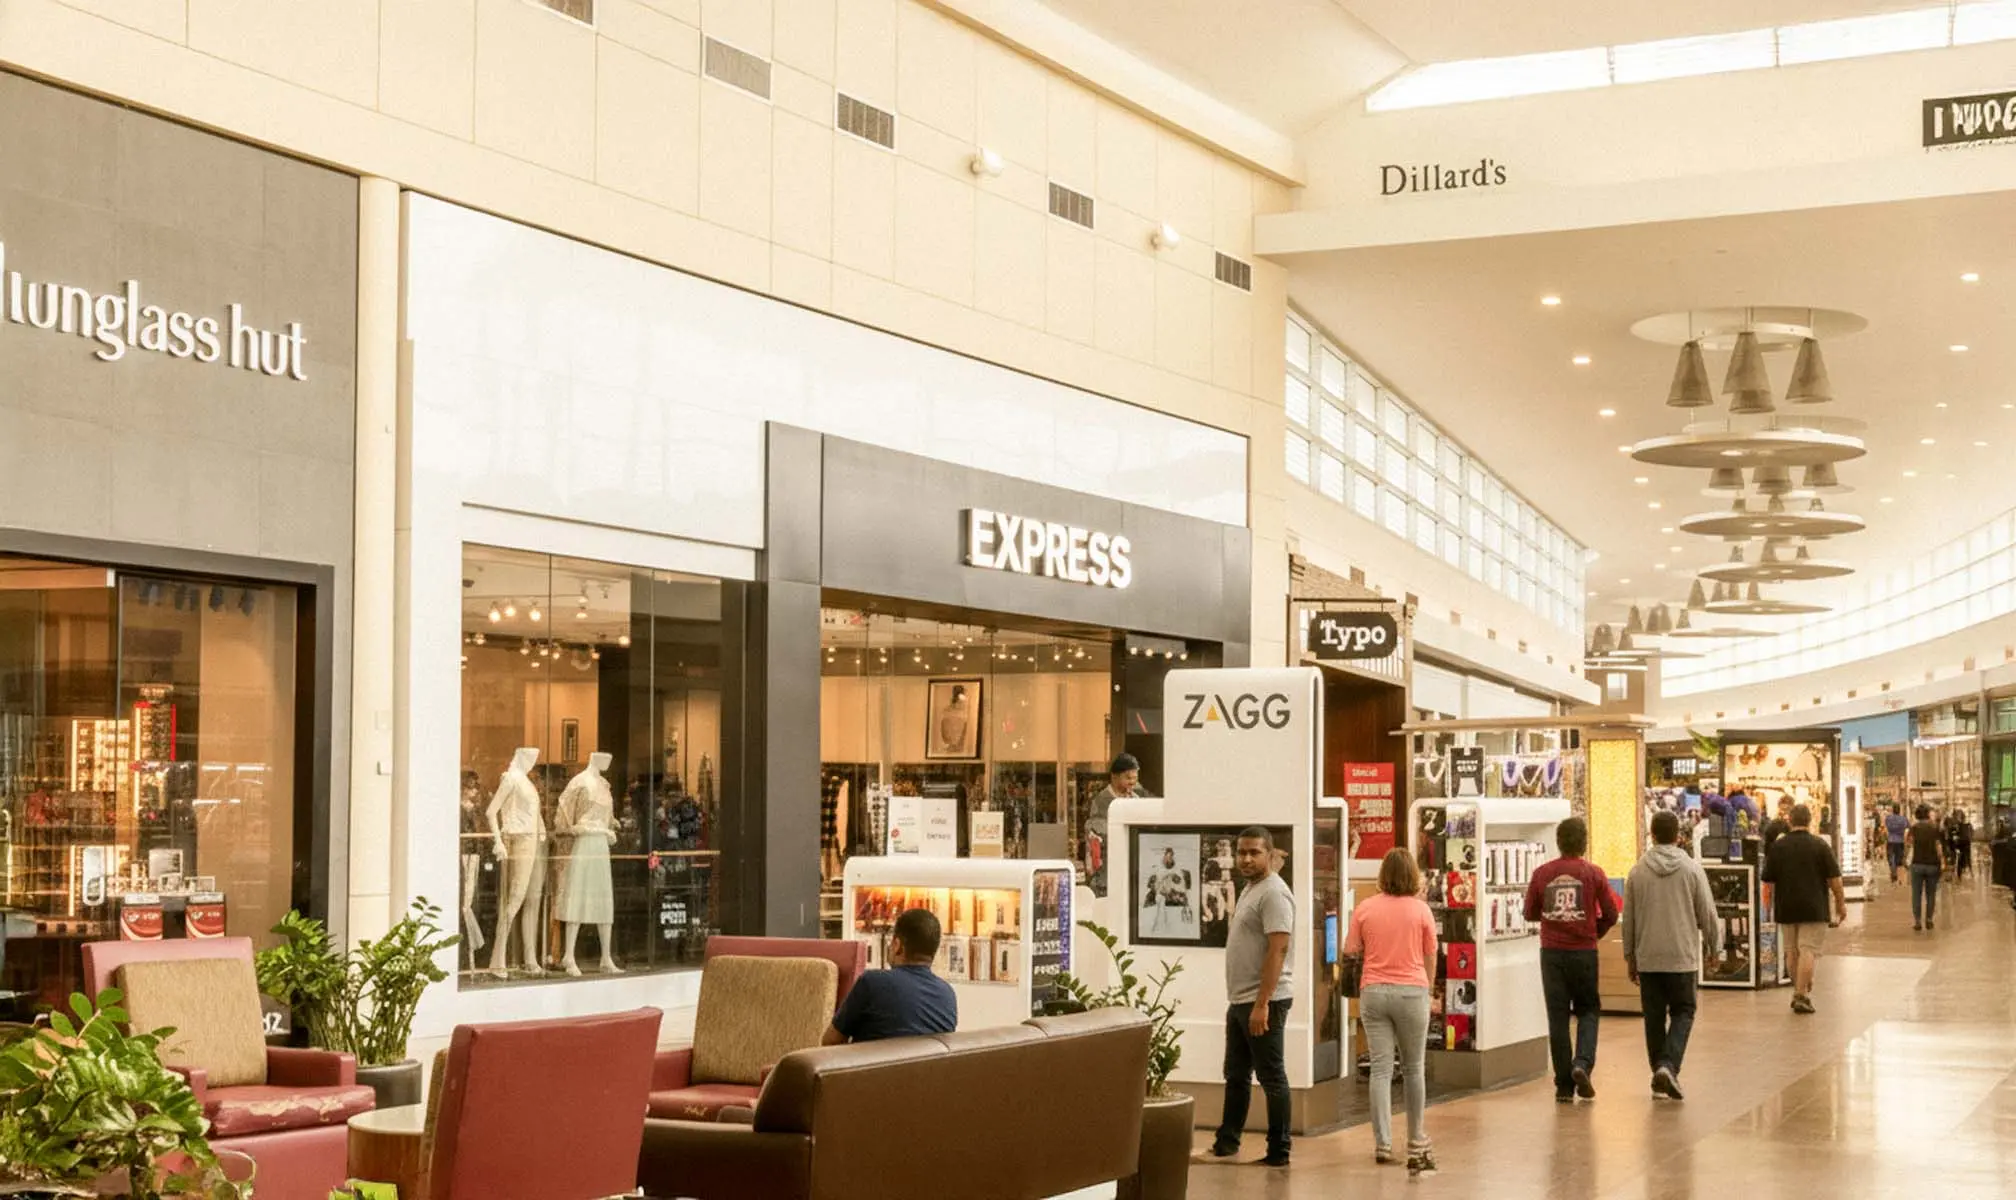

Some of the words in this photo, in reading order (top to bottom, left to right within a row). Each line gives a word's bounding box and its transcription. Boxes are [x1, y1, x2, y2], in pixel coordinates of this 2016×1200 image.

[1379, 158, 1507, 196] Dillard's
[230, 302, 308, 382] hut
[968, 507, 1132, 589] EXPRESS
[1319, 618, 1387, 652] Typo
[1182, 692, 1291, 730] ZAGG
